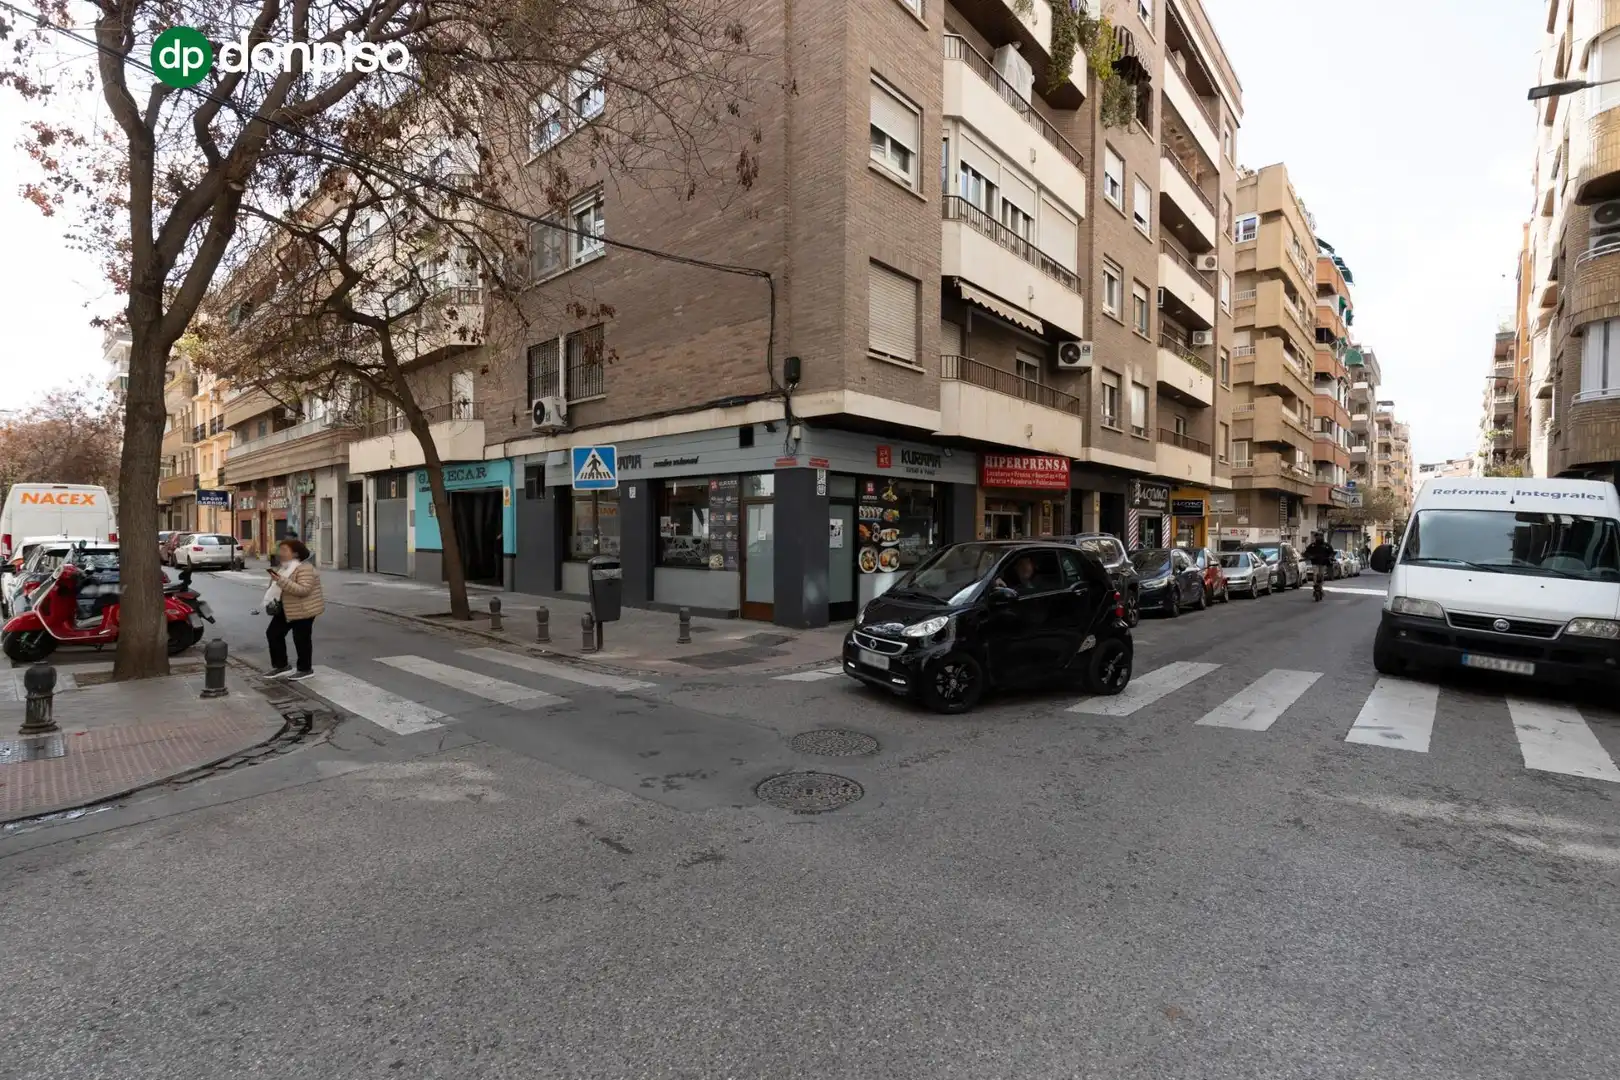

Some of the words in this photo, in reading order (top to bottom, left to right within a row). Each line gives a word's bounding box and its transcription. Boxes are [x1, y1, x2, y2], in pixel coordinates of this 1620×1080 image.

[984, 456, 1068, 472] HIPERPRENSA
[418, 467, 487, 484] GECAR
[20, 492, 96, 506] NACEX
[1432, 488, 1507, 496] Reformas
[1515, 489, 1605, 501] Integrales
